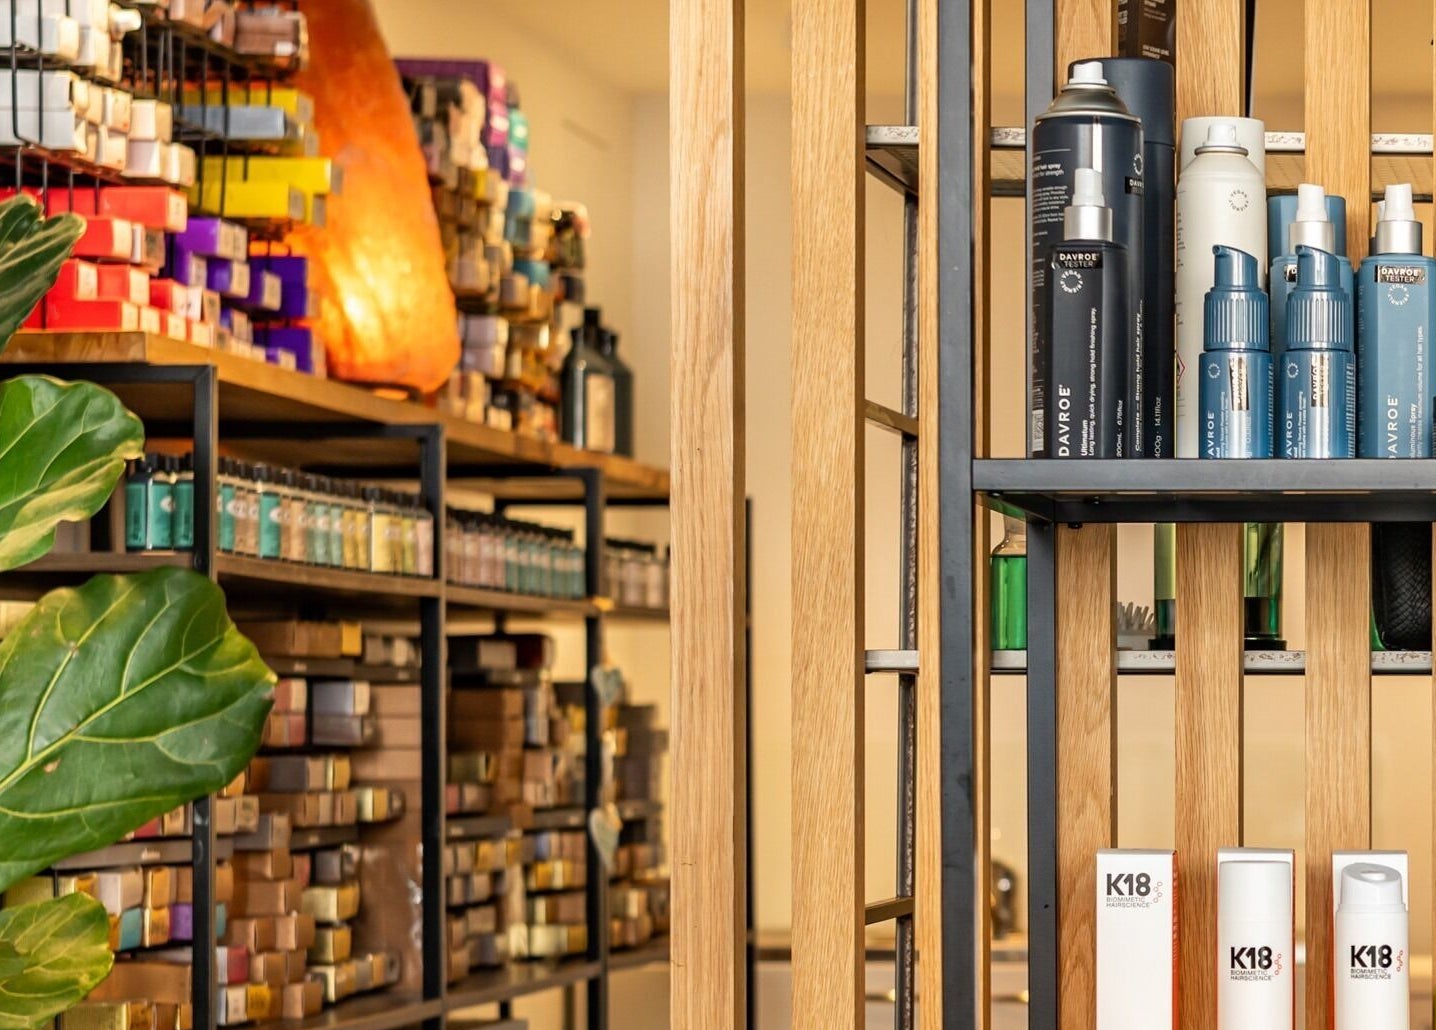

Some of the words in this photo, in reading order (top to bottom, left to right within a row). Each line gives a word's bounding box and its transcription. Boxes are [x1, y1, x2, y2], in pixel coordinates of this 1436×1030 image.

[1059, 253, 1098, 261] DAVROE
[1064, 260, 1095, 268] TESTER
[1381, 268, 1420, 277] DAVROE
[1386, 275, 1415, 283] TESTER
[1089, 324, 1097, 349] finishing
[1089, 362, 1097, 382] strong
[1058, 386, 1072, 457] DAVROE
[1408, 403, 1417, 424] Spray
[1080, 419, 1089, 456] Ultimatum
[1088, 440, 1096, 456] Long
[1106, 872, 1151, 896] K18
[1230, 946, 1273, 970] K18
[1351, 945, 1392, 968] K18
